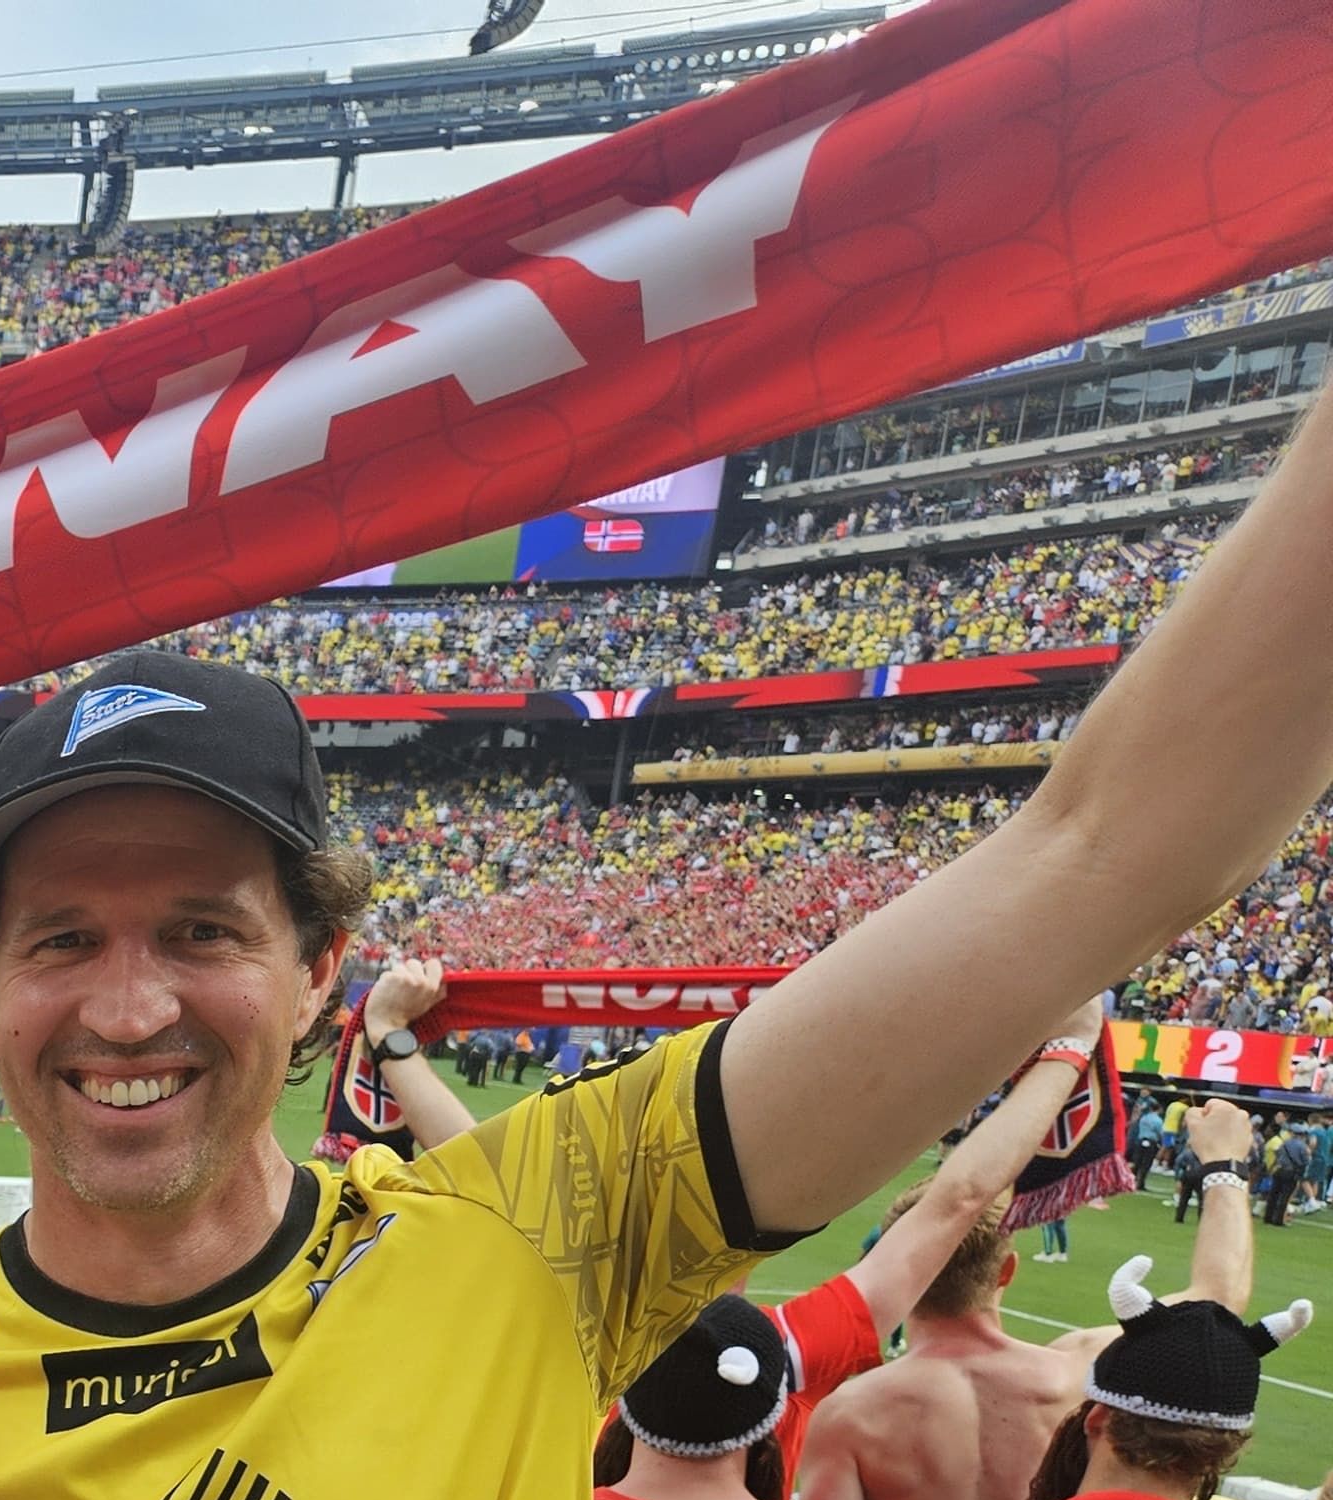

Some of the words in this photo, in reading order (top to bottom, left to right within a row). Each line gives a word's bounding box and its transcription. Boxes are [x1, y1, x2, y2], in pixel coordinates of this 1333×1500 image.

[82, 691, 148, 725] Start
[1135, 1023, 1161, 1073] 1
[1200, 1030, 1244, 1082] 2
